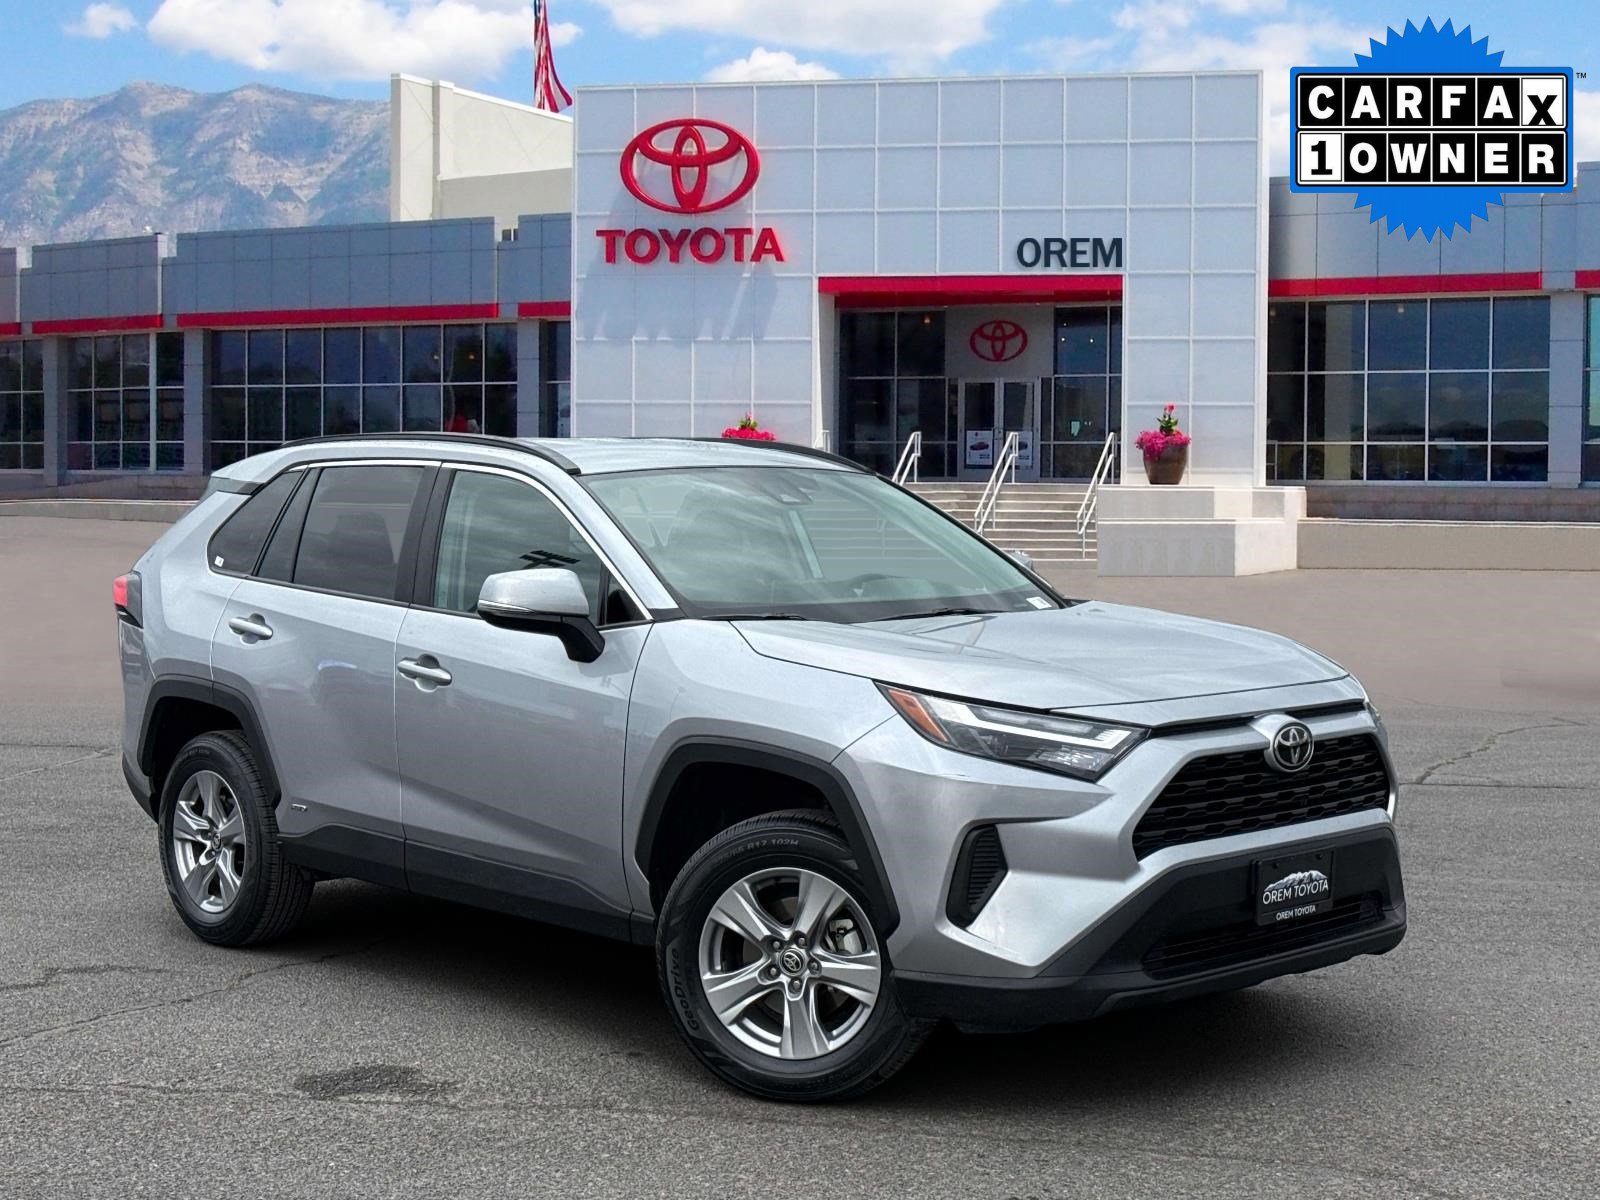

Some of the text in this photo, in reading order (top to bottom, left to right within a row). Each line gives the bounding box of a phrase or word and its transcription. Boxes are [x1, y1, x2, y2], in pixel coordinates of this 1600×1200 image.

[596, 227, 785, 264] TOYOTA
[1017, 237, 1122, 268] OREM
[1262, 879, 1329, 905] OREM TOYOTA
[1275, 905, 1316, 921] OREM TOYOTA
